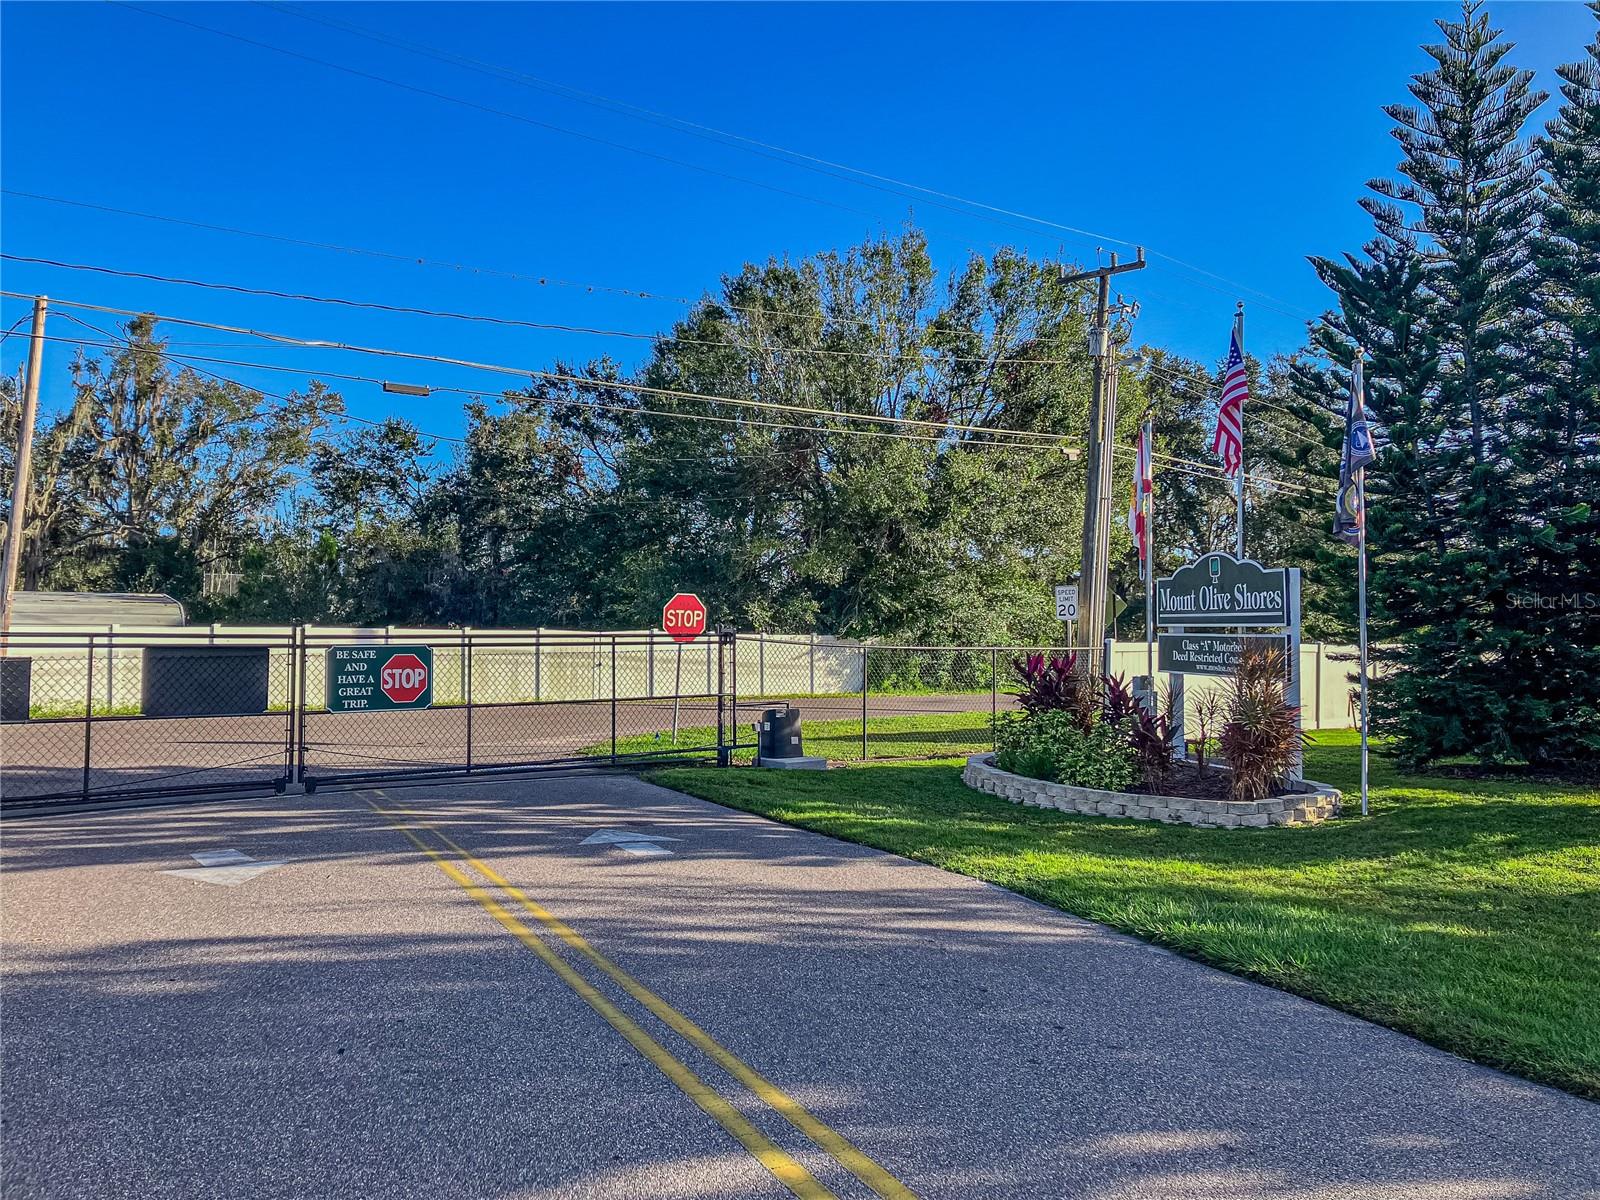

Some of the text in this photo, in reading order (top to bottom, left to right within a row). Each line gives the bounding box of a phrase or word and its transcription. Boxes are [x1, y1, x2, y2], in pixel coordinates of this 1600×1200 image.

[1160, 583, 1282, 611] Mount Olive Shores
[1058, 603, 1076, 617] 20
[666, 609, 703, 627] STOP
[1182, 640, 1199, 651] Class
[336, 650, 377, 659] BE SAFE
[1173, 650, 1188, 661] Deed
[1189, 651, 1223, 664] Restricted
[344, 662, 367, 672] AND
[337, 674, 375, 684] HAVE A
[383, 668, 425, 689] STOP
[338, 687, 374, 697] GREAT
[342, 699, 369, 709] TRIP.
